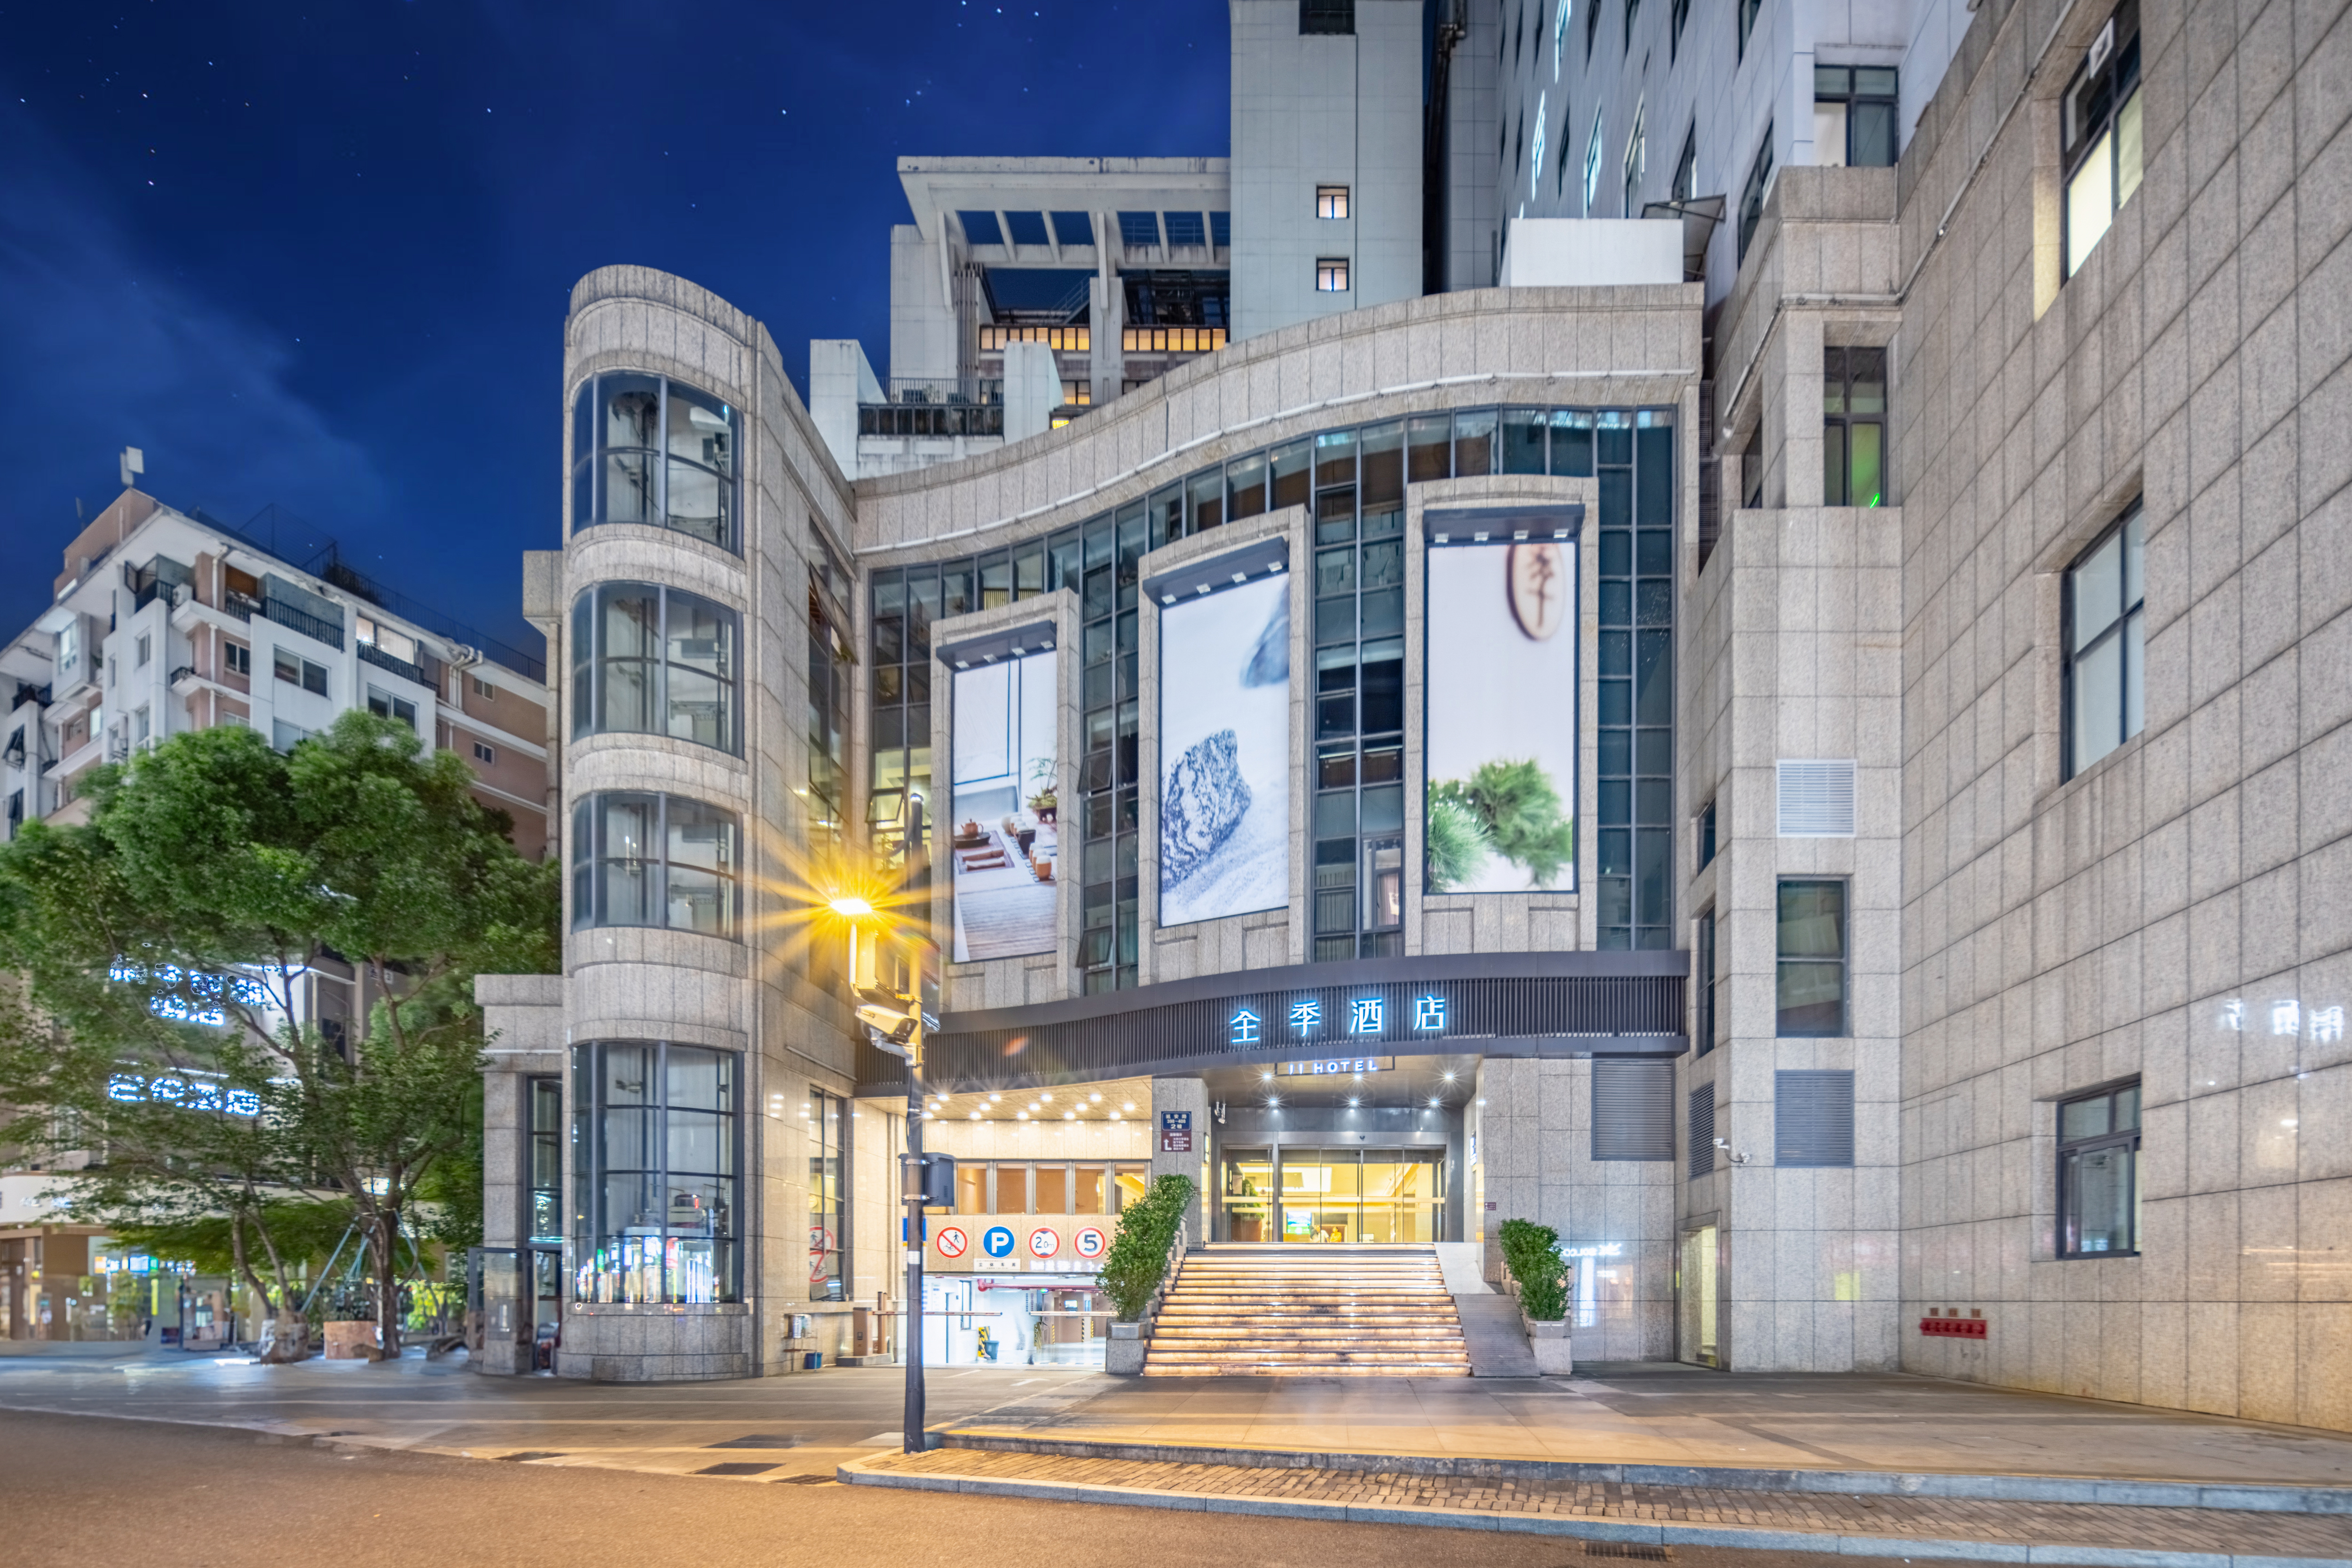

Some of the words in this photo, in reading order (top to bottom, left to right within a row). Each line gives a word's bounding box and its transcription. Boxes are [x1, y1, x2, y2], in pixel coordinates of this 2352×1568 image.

[1230, 995, 1446, 1043] 全季酒店
[1313, 1059, 1378, 1074] HOTEL
[991, 1233, 1009, 1253] P
[1084, 1234, 1098, 1252] 5
